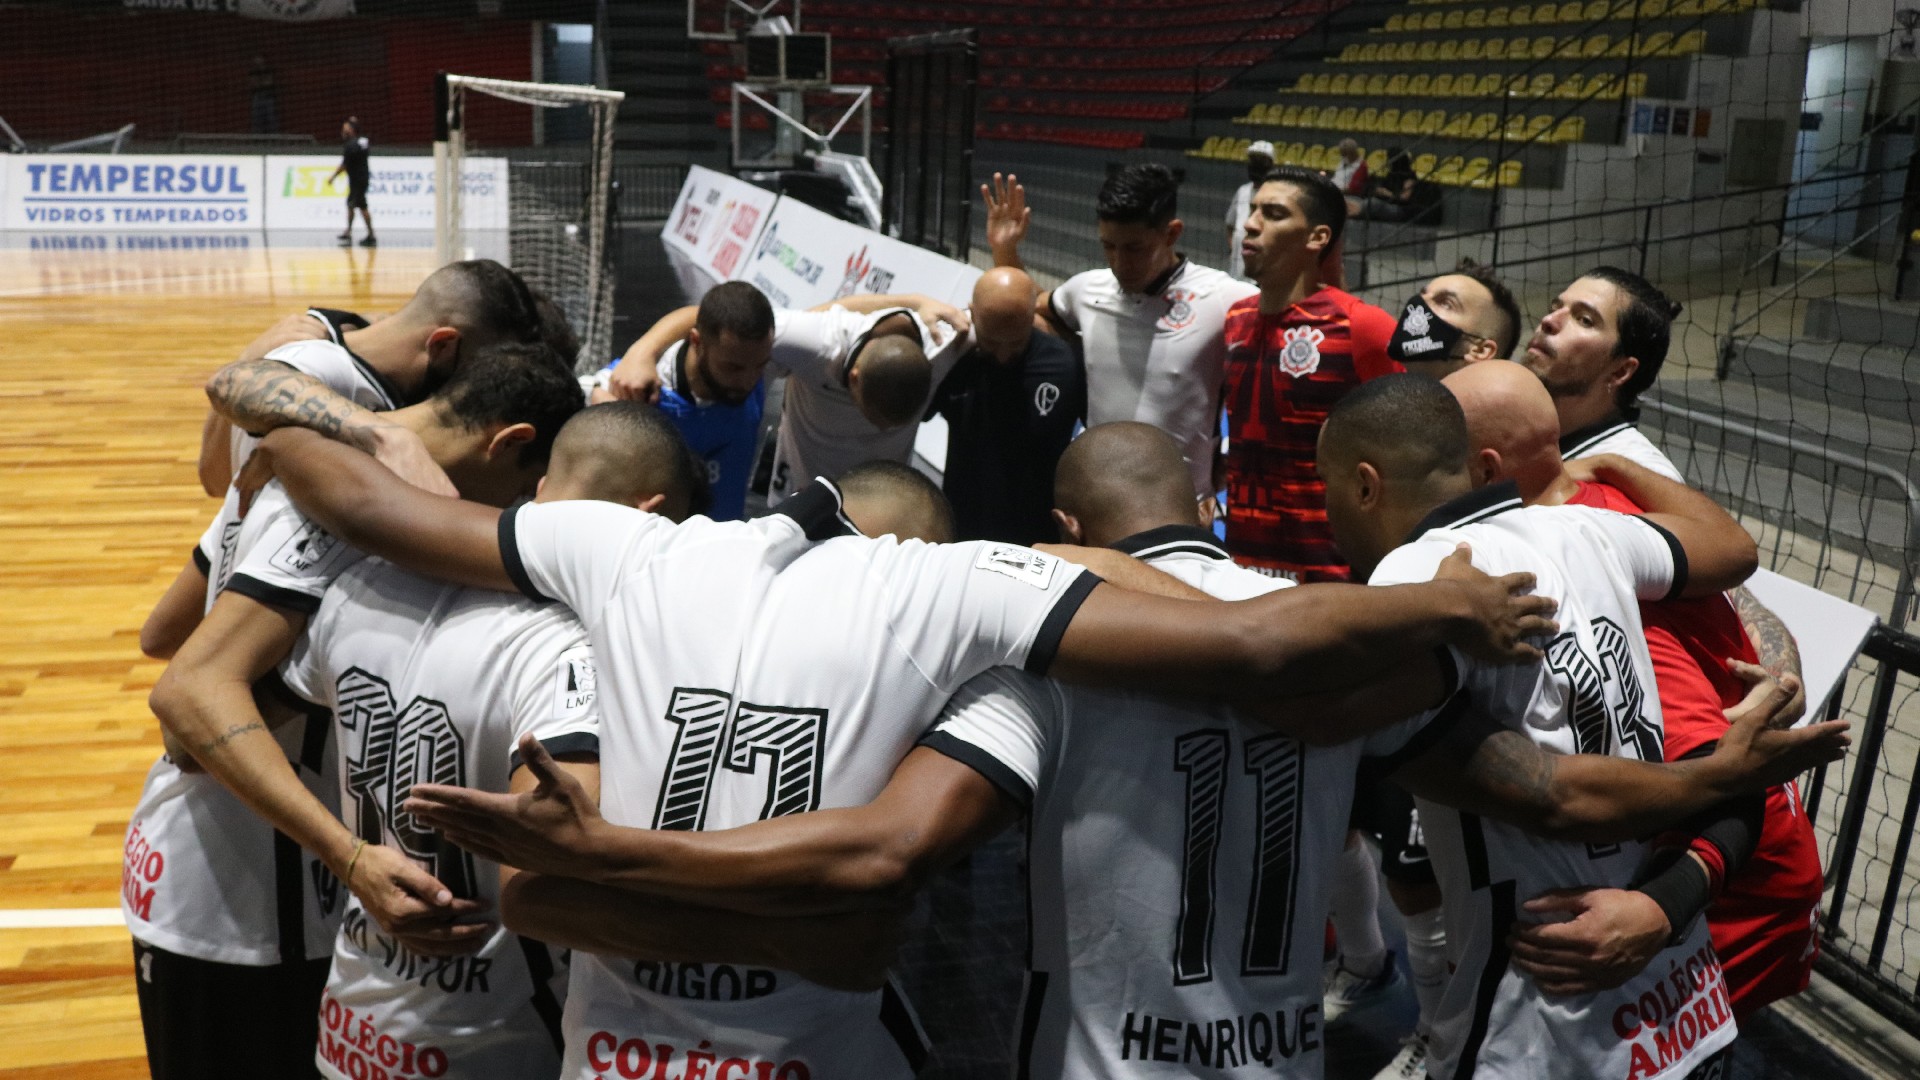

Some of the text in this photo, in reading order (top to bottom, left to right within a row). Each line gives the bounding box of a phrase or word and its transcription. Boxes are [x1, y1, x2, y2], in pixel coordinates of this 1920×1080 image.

[27, 164, 245, 193] TEMPERSUL
[25, 207, 248, 223] VIDROS TEMPERADOS
[285, 555, 313, 572] LNF
[1030, 556, 1047, 576] LNF
[565, 694, 594, 710] LNF
[652, 686, 829, 831] 17
[1173, 728, 1306, 986] 11
[319, 986, 449, 1078] OLÉGIO
[1122, 1004, 1320, 1069] HENRIQUE
